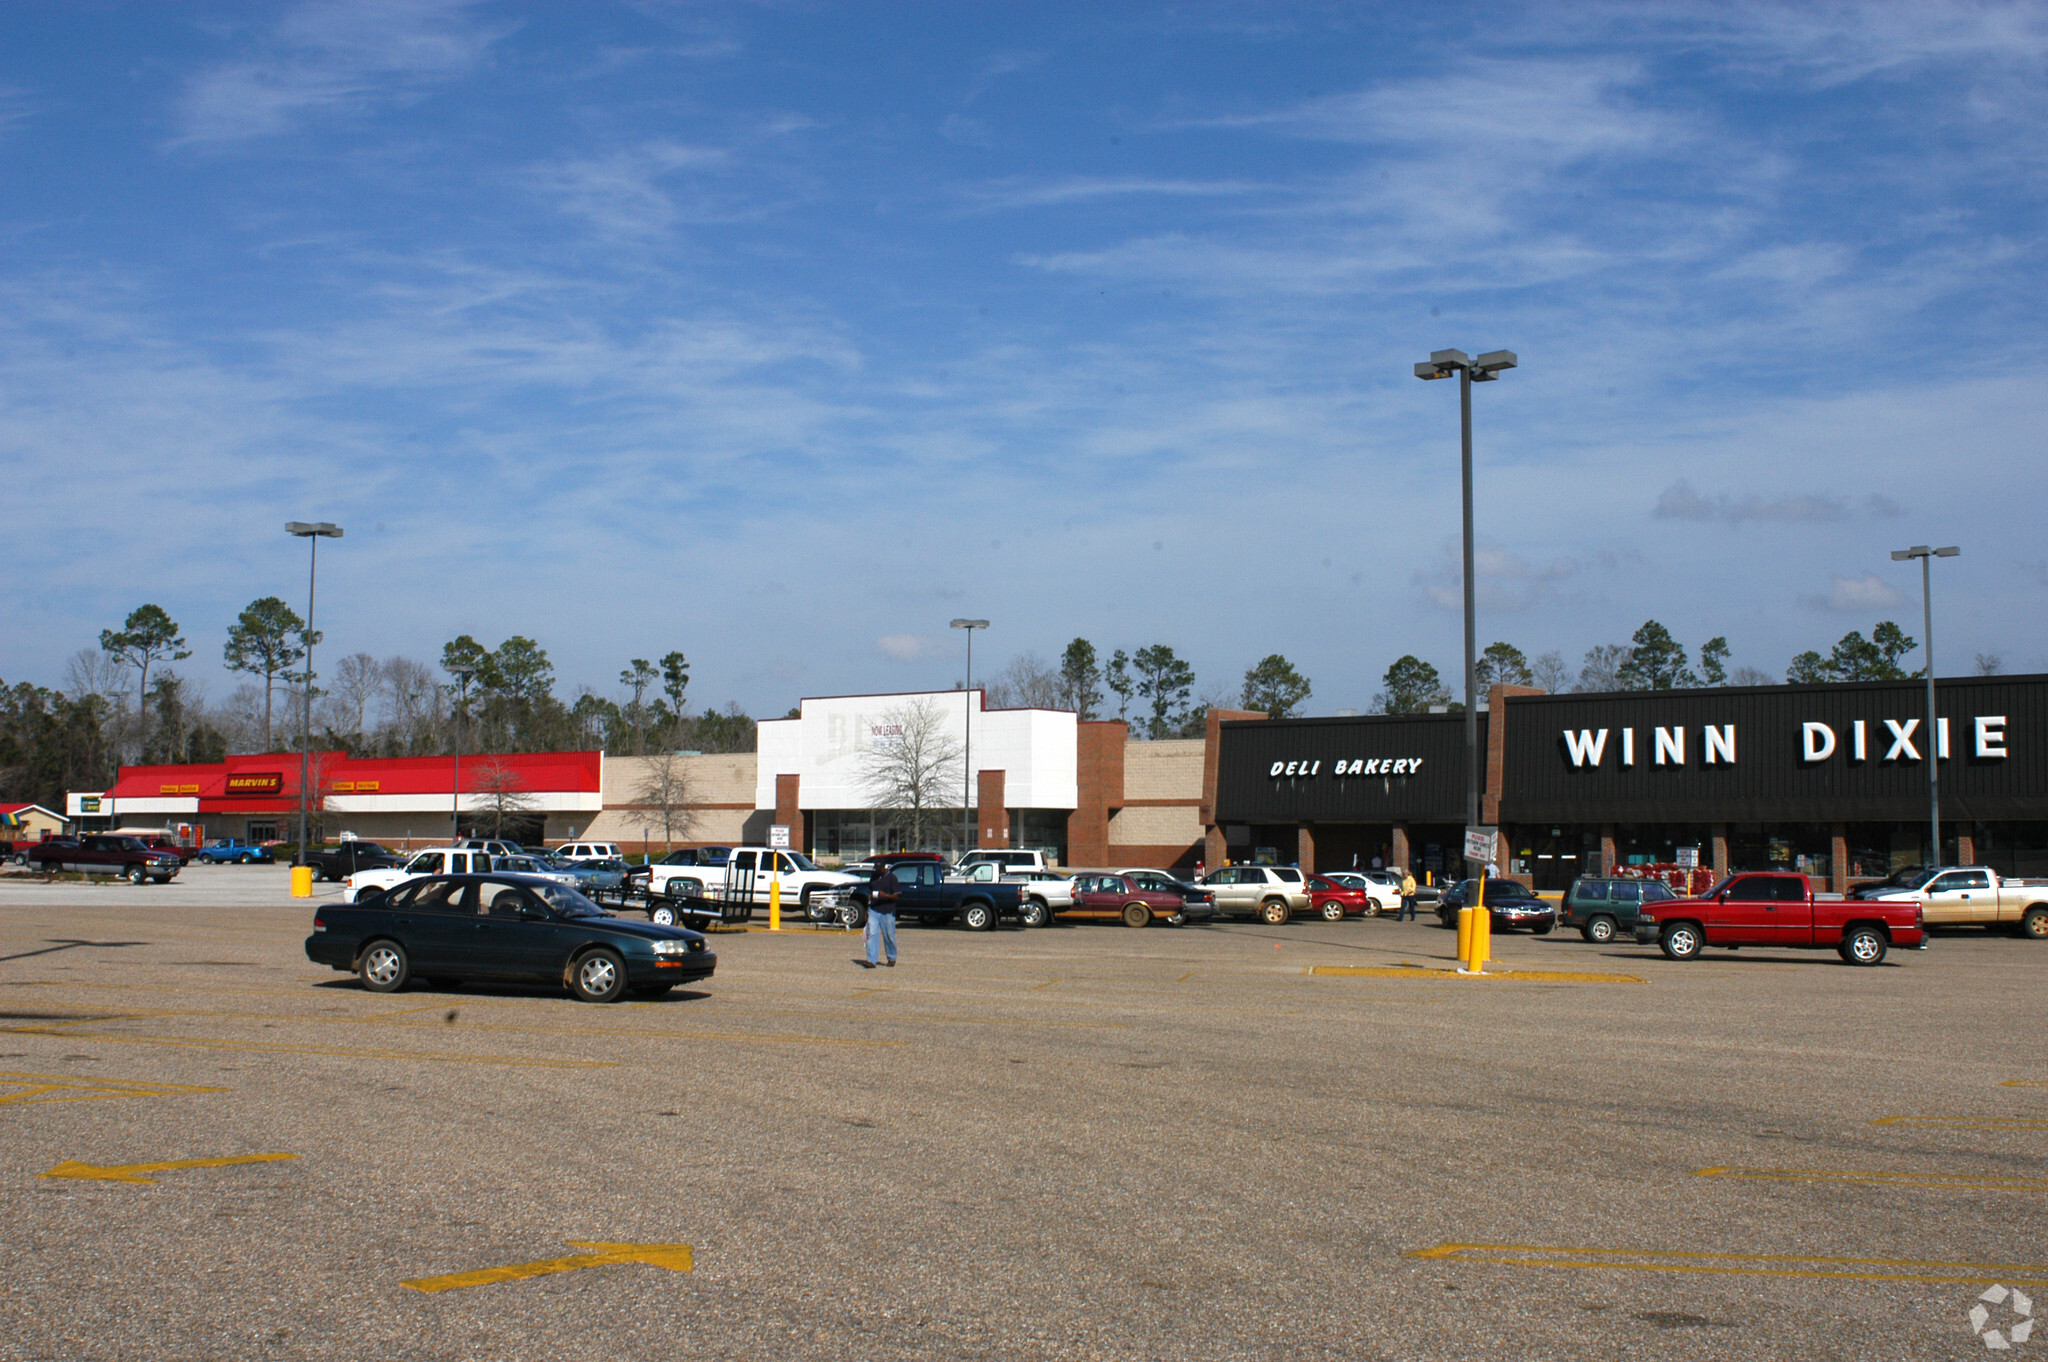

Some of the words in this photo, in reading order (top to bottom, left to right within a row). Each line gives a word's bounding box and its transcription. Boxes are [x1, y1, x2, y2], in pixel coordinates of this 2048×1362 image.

[1563, 724, 1736, 767] WINN
[1802, 716, 2007, 761] DIXIE
[1270, 760, 1321, 776] DELI
[1334, 758, 1422, 775] BAKERY
[229, 778, 277, 787] MARVIN'S
